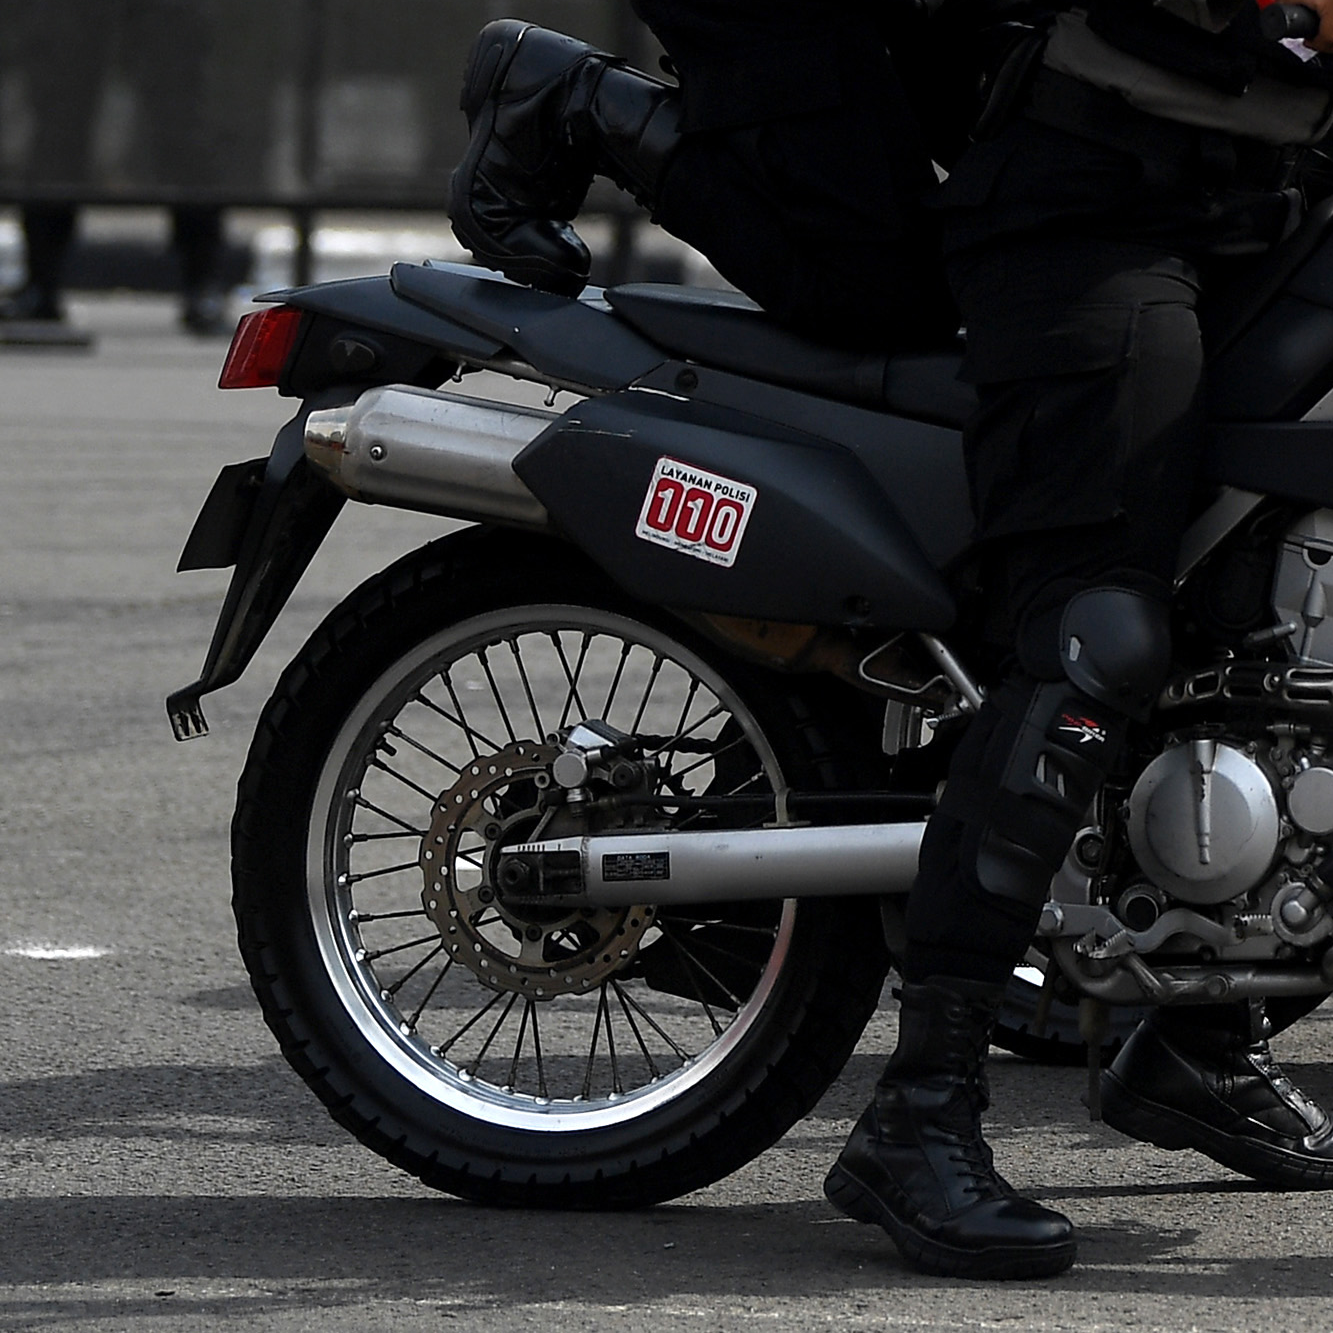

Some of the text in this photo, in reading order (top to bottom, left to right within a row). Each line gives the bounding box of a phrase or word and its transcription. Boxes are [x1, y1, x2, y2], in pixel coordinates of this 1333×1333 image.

[660, 465, 751, 503] LAYANAN POLISI
[655, 485, 740, 547] 110
